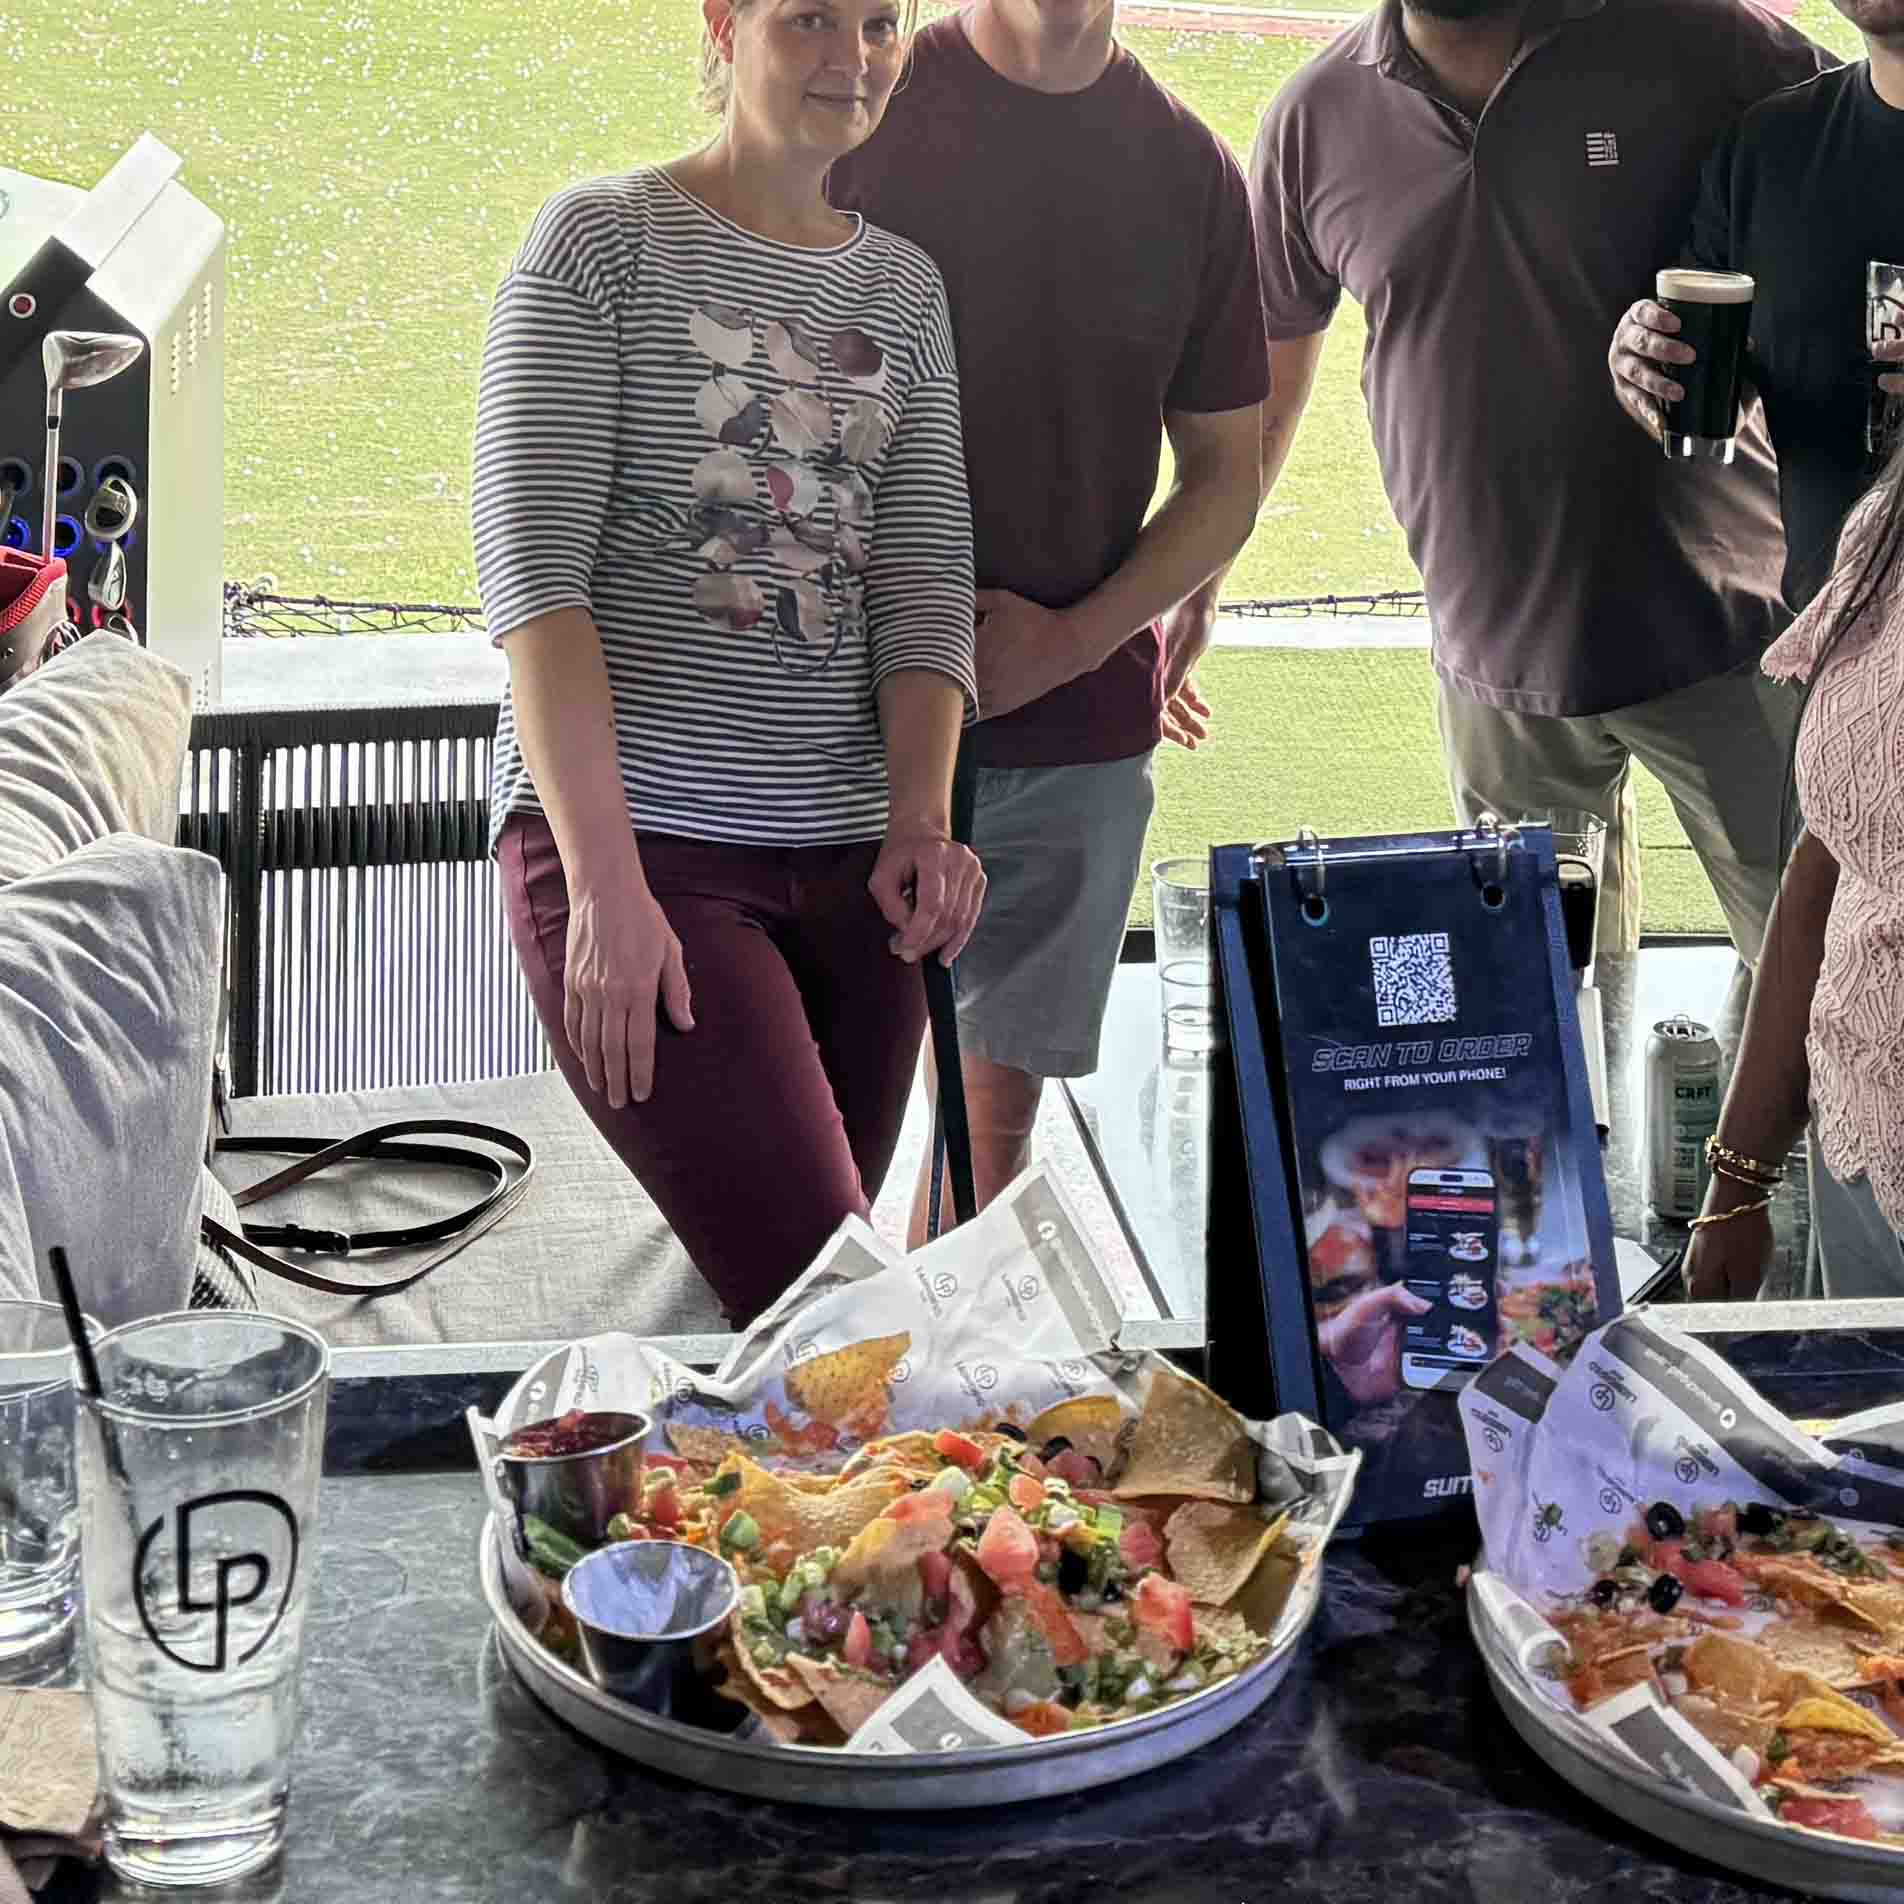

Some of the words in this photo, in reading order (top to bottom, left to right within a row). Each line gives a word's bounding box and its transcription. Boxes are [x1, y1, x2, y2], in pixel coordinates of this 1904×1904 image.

[1311, 1044, 1393, 1073] SCAN
[1396, 1040, 1433, 1065] TO
[1438, 1033, 1534, 1062] ORDER
[1343, 1076, 1382, 1092] RIGHT
[1384, 1073, 1421, 1089] FROM
[1422, 1069, 1458, 1085] YOUR
[1459, 1066, 1507, 1083] PHONE!
[133, 1489, 299, 1673] LP
